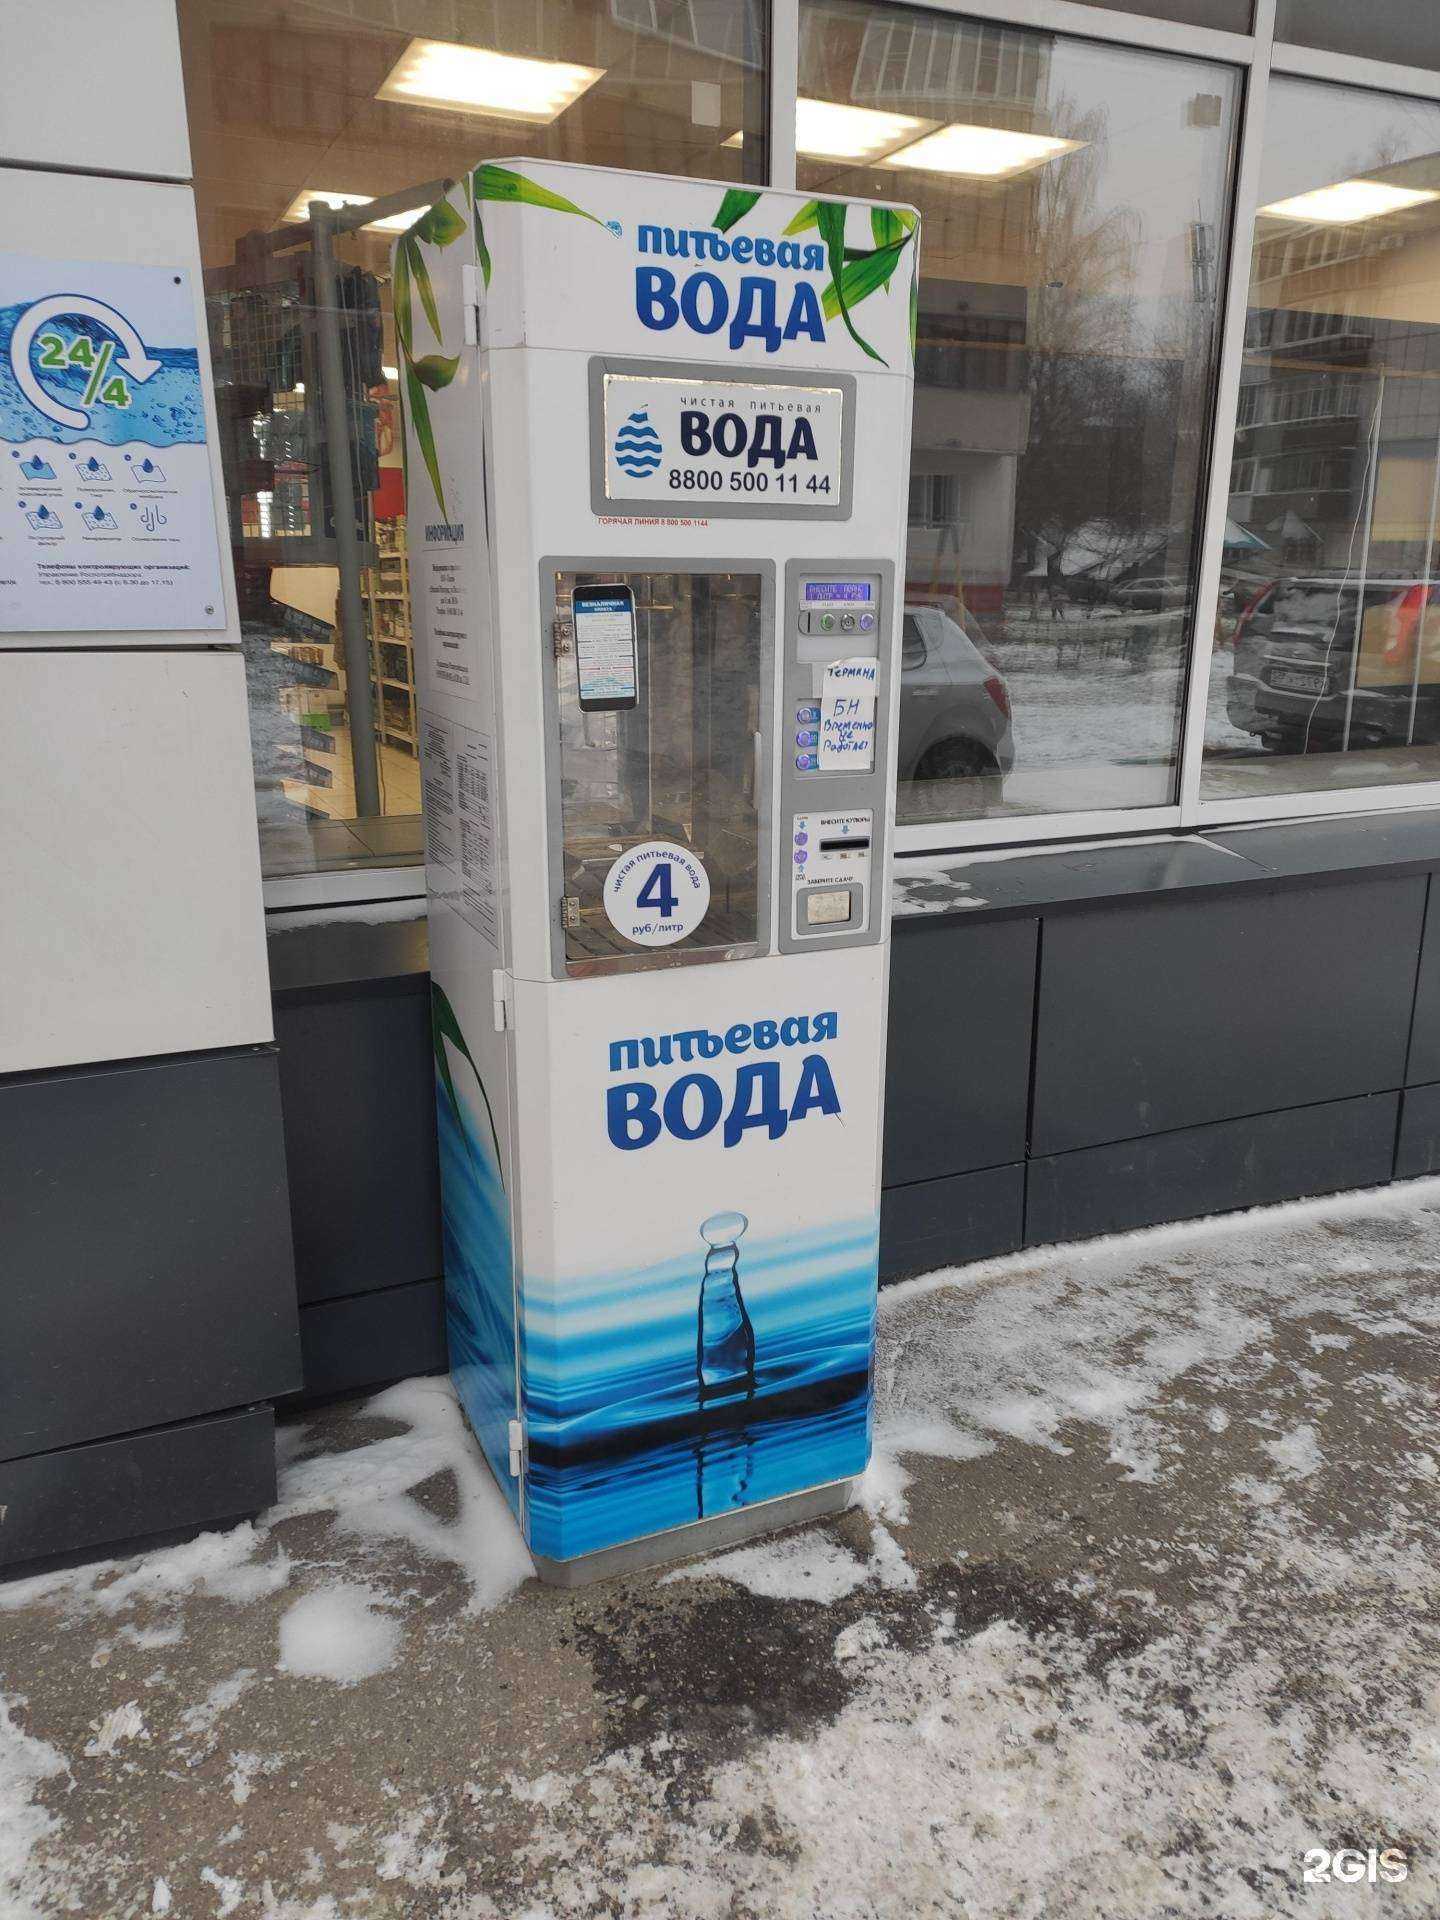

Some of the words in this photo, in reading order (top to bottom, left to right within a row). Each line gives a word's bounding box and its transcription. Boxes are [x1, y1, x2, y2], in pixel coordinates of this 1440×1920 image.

[637, 224, 824, 271] питьевая
[635, 266, 826, 352] ВОДА
[680, 396, 734, 408] чистая
[750, 401, 821, 413] питьевая
[680, 410, 818, 469] ВОДА
[668, 469, 723, 490] 8800
[729, 472, 768, 492] 500
[776, 474, 798, 493] 11
[806, 475, 831, 494] 44
[598, 517, 633, 526] ГОРЯЧАЯ
[634, 518, 660, 527] ЛИНИЯ
[613, 860, 636, 893] чистая
[636, 850, 686, 864] питьевая
[684, 864, 701, 889] вода
[636, 863, 679, 917] 4
[632, 923, 684, 936] руб/литр
[609, 1011, 838, 1072] питьевая
[606, 1054, 842, 1151] ВОДА
